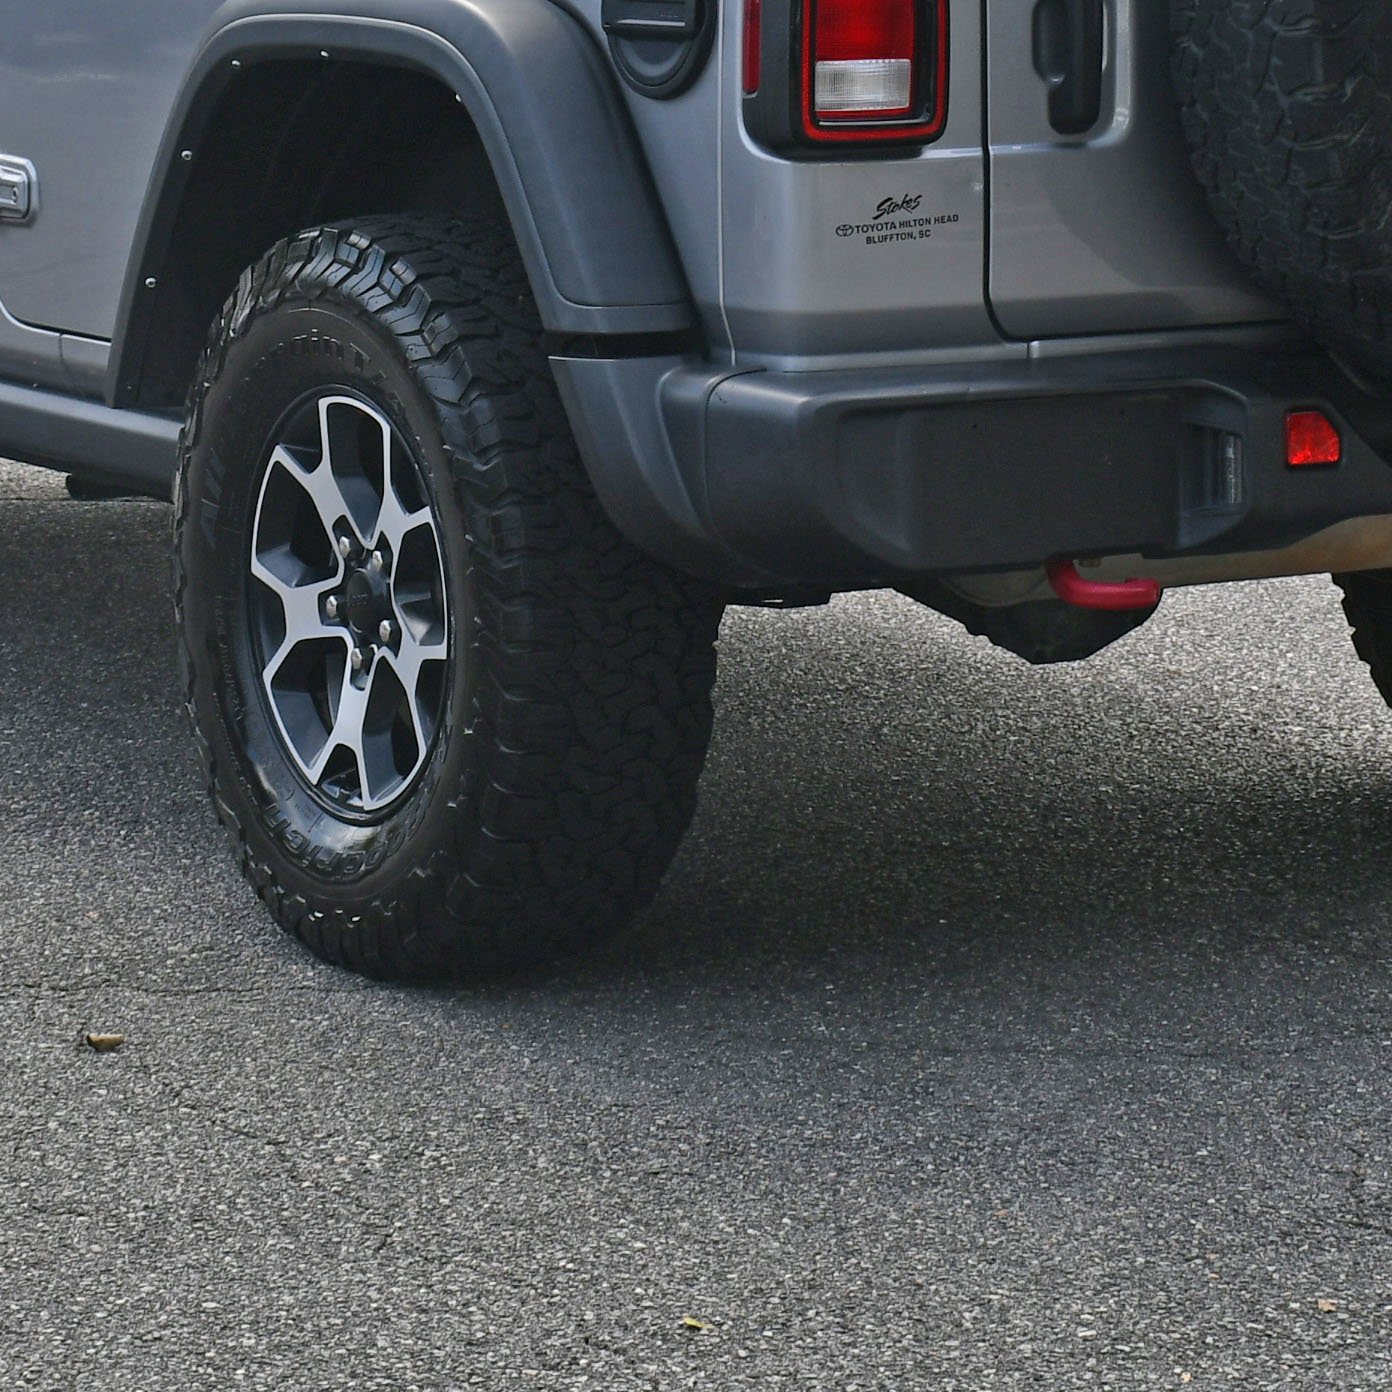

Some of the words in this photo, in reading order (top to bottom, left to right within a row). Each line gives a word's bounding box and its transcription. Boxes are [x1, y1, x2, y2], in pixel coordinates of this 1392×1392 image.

[872, 193, 923, 220] Stokes
[855, 222, 897, 234] TOYOTA
[899, 217, 931, 229] HILTON
[934, 214, 959, 225] HEAD
[865, 230, 917, 245] BLUFFTON,
[919, 229, 931, 239] SC
